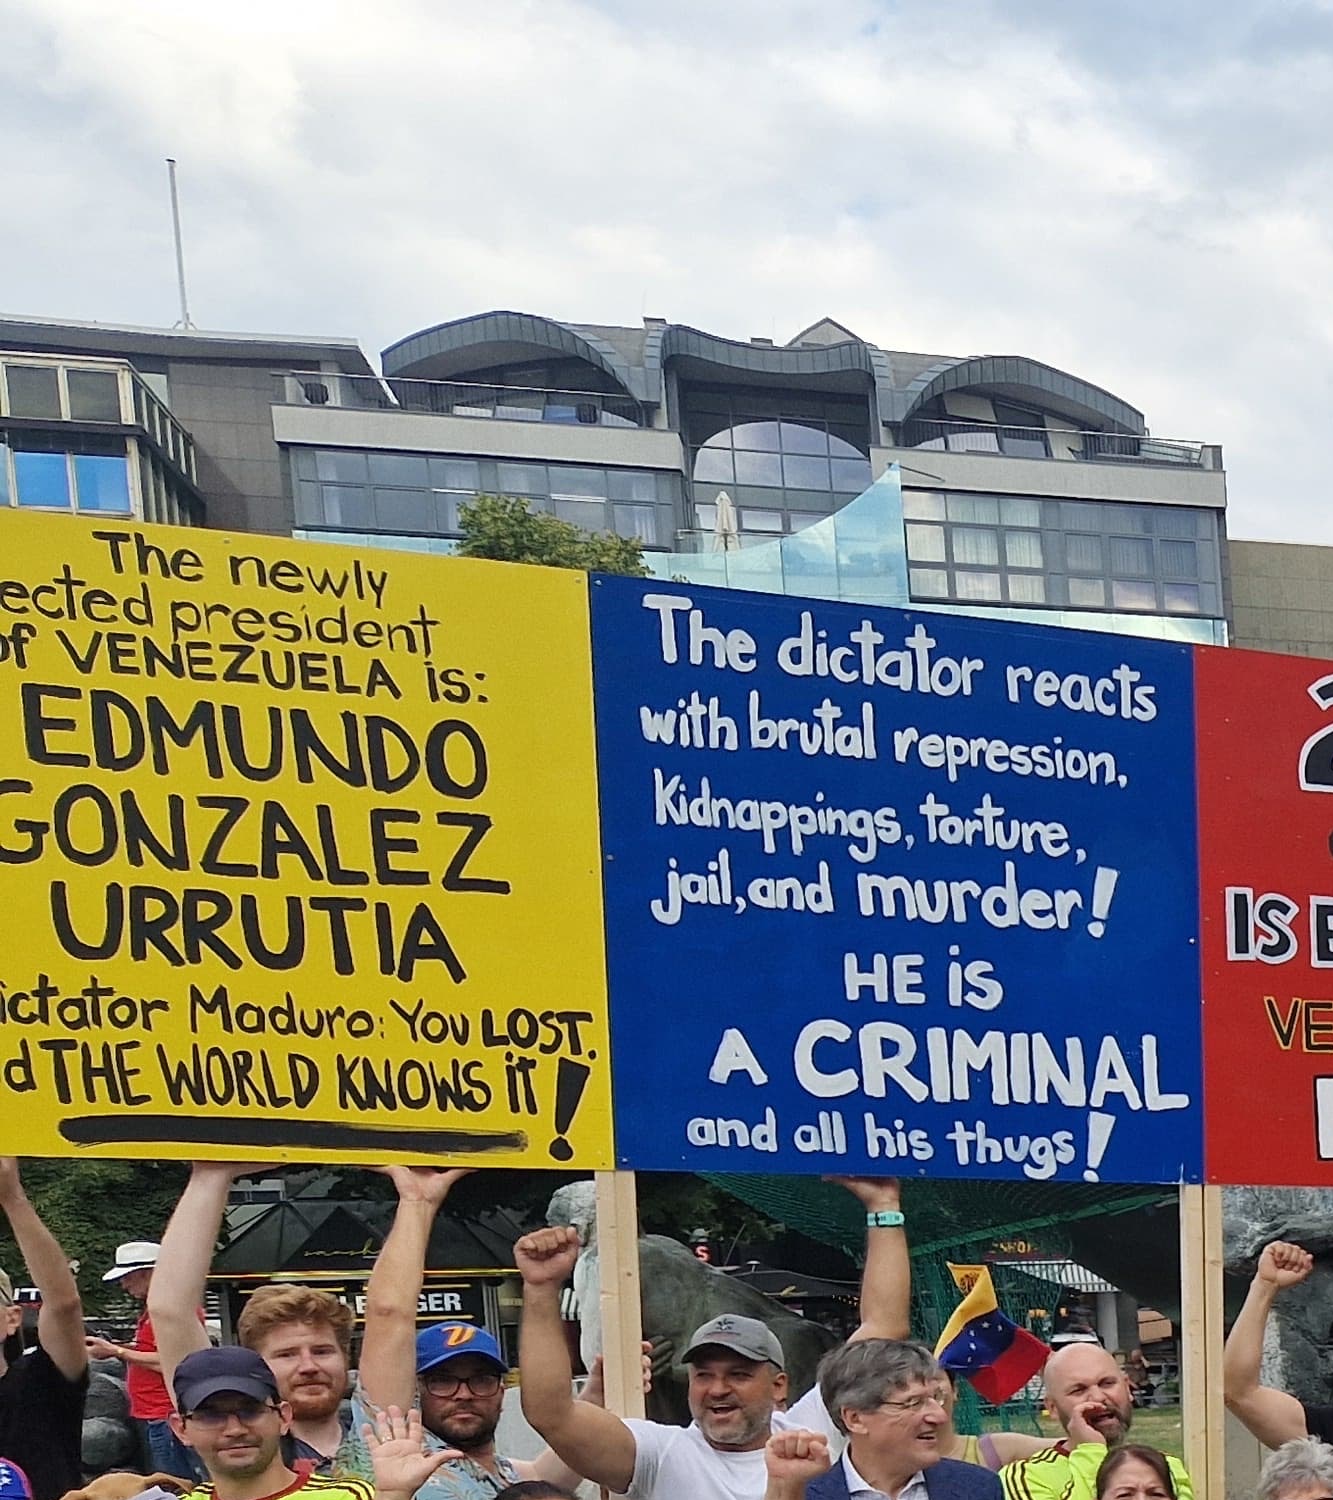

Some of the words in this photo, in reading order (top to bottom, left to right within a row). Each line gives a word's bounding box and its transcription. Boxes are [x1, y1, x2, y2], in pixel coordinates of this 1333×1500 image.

[93, 530, 202, 581] The
[231, 556, 388, 600] newly
[0, 563, 153, 625] ected
[171, 601, 440, 657] president
[55, 629, 402, 701] VENEZUELA
[642, 593, 758, 673] The
[777, 611, 985, 698] dictator
[1006, 663, 1159, 721] reacts
[21, 682, 487, 800] EDMUNDO
[640, 691, 738, 752] with
[750, 690, 876, 761] brutal
[894, 727, 1129, 787] repression,
[0, 778, 510, 894] GONZALEZ
[918, 793, 1088, 866] torture,
[50, 881, 466, 983] URRUTIA
[856, 862, 1119, 939] murder!
[1224, 886, 1299, 966] IS
[843, 951, 926, 1005] HE
[190, 985, 387, 1039] Maduro:
[482, 1008, 599, 1060] LOST.
[38, 1038, 152, 1106] THE
[156, 1048, 320, 1112] WORLD
[337, 1053, 492, 1113] KNOWS
[708, 1027, 768, 1087] A
[794, 1018, 1191, 1111] CRIMINAL
[687, 1108, 778, 1153] and
[793, 1111, 847, 1155] all
[863, 1112, 935, 1161] his
[946, 1110, 1117, 1184] thugs!
